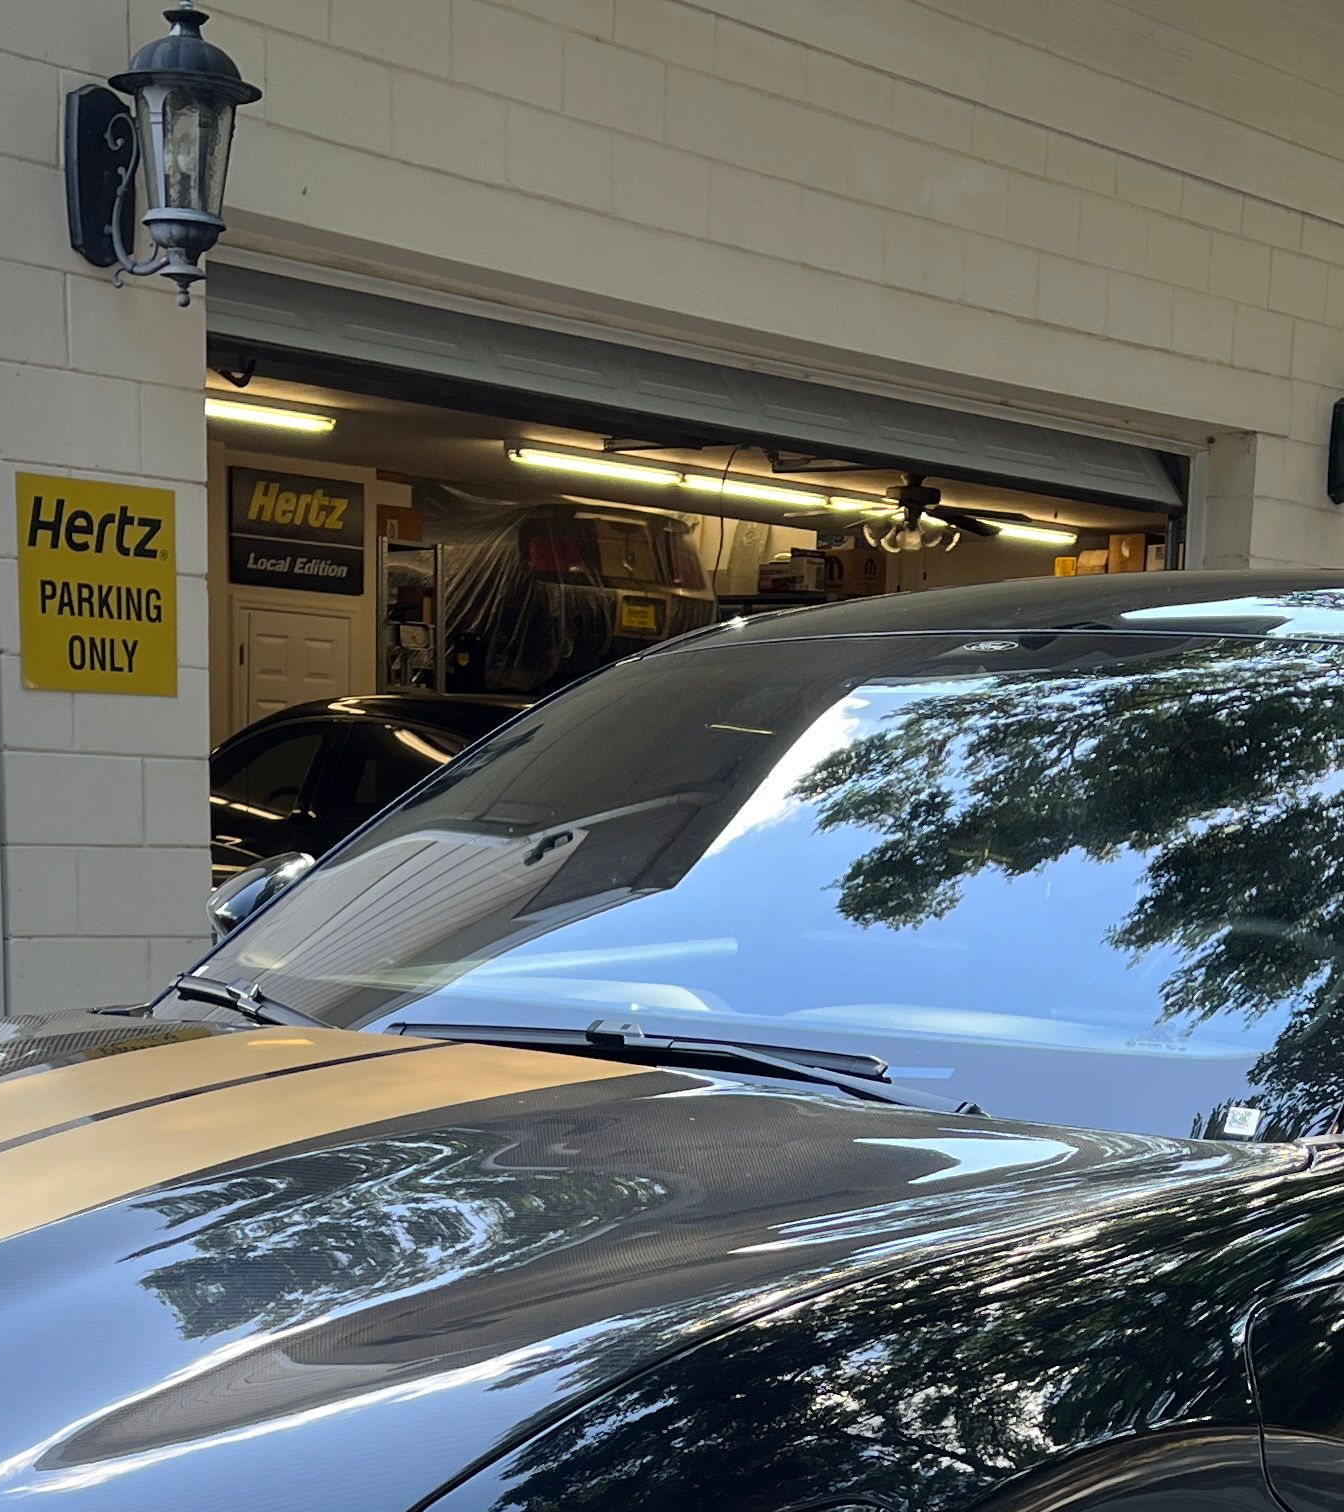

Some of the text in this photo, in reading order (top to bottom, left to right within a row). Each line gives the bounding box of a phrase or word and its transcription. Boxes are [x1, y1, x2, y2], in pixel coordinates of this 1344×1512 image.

[28, 496, 162, 558] Hertz
[247, 481, 349, 530] Hertz
[247, 552, 348, 578] Local Edition
[40, 579, 162, 624] PARKING
[68, 635, 138, 673] ONLY
